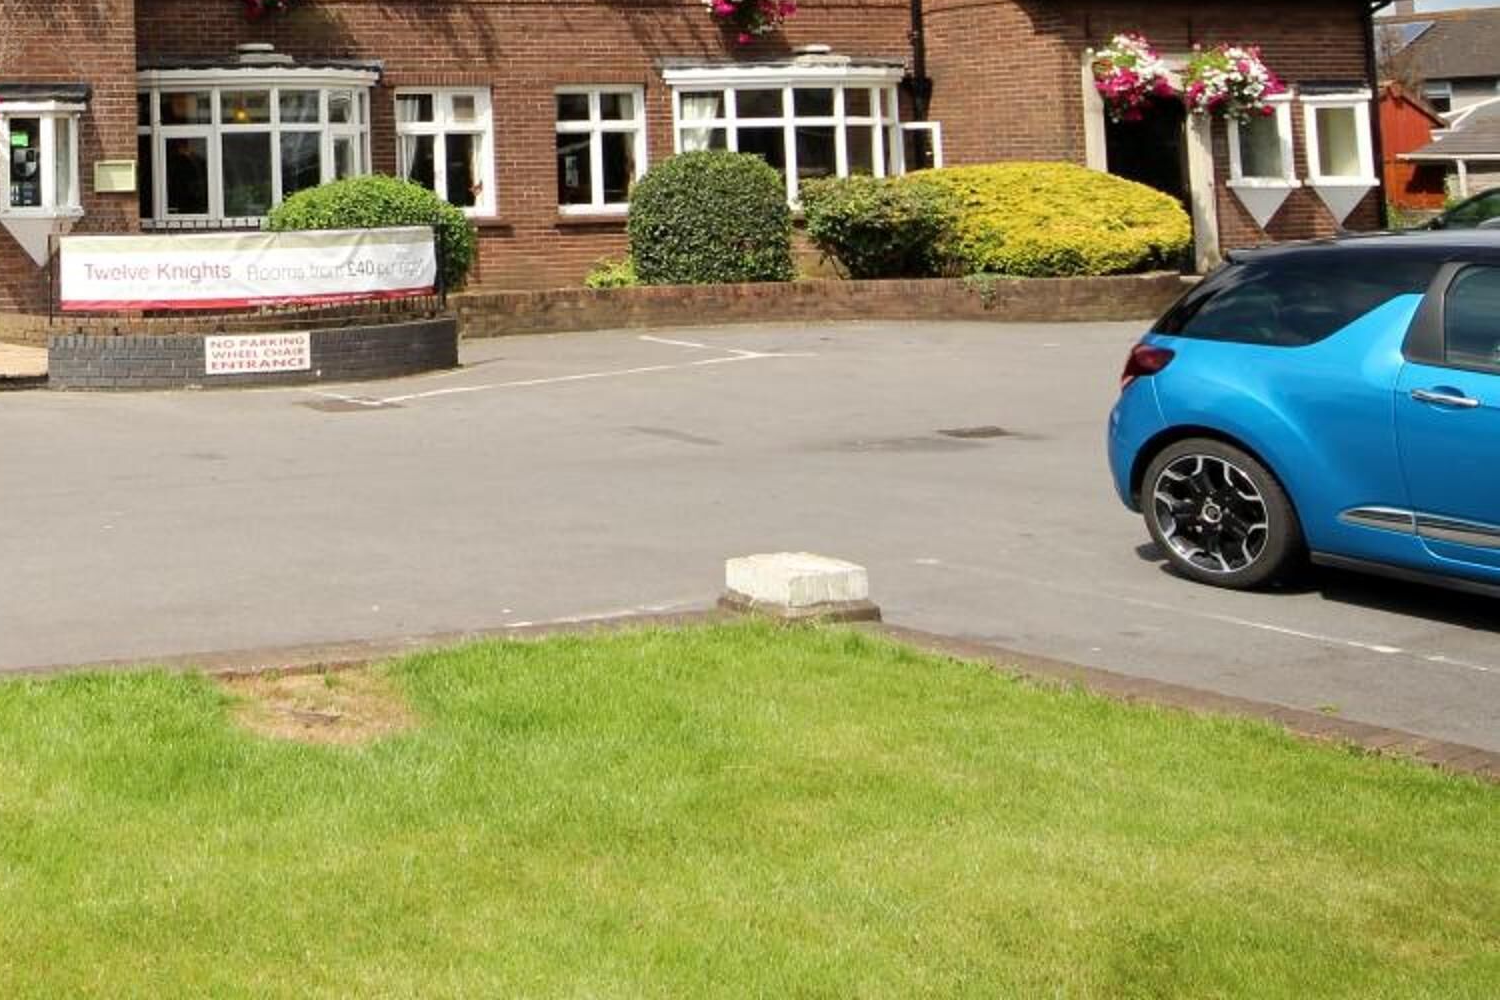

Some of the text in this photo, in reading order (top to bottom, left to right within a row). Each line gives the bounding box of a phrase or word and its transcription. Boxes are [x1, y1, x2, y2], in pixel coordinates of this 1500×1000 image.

[84, 264, 149, 281] Twelve
[157, 262, 232, 284] Knights
[247, 264, 305, 281] Rooms
[347, 259, 374, 277] £40
[210, 336, 305, 348] NO PARKING
[212, 347, 304, 359] WHEEL CHAIR
[211, 358, 304, 370] ENTRANCE
